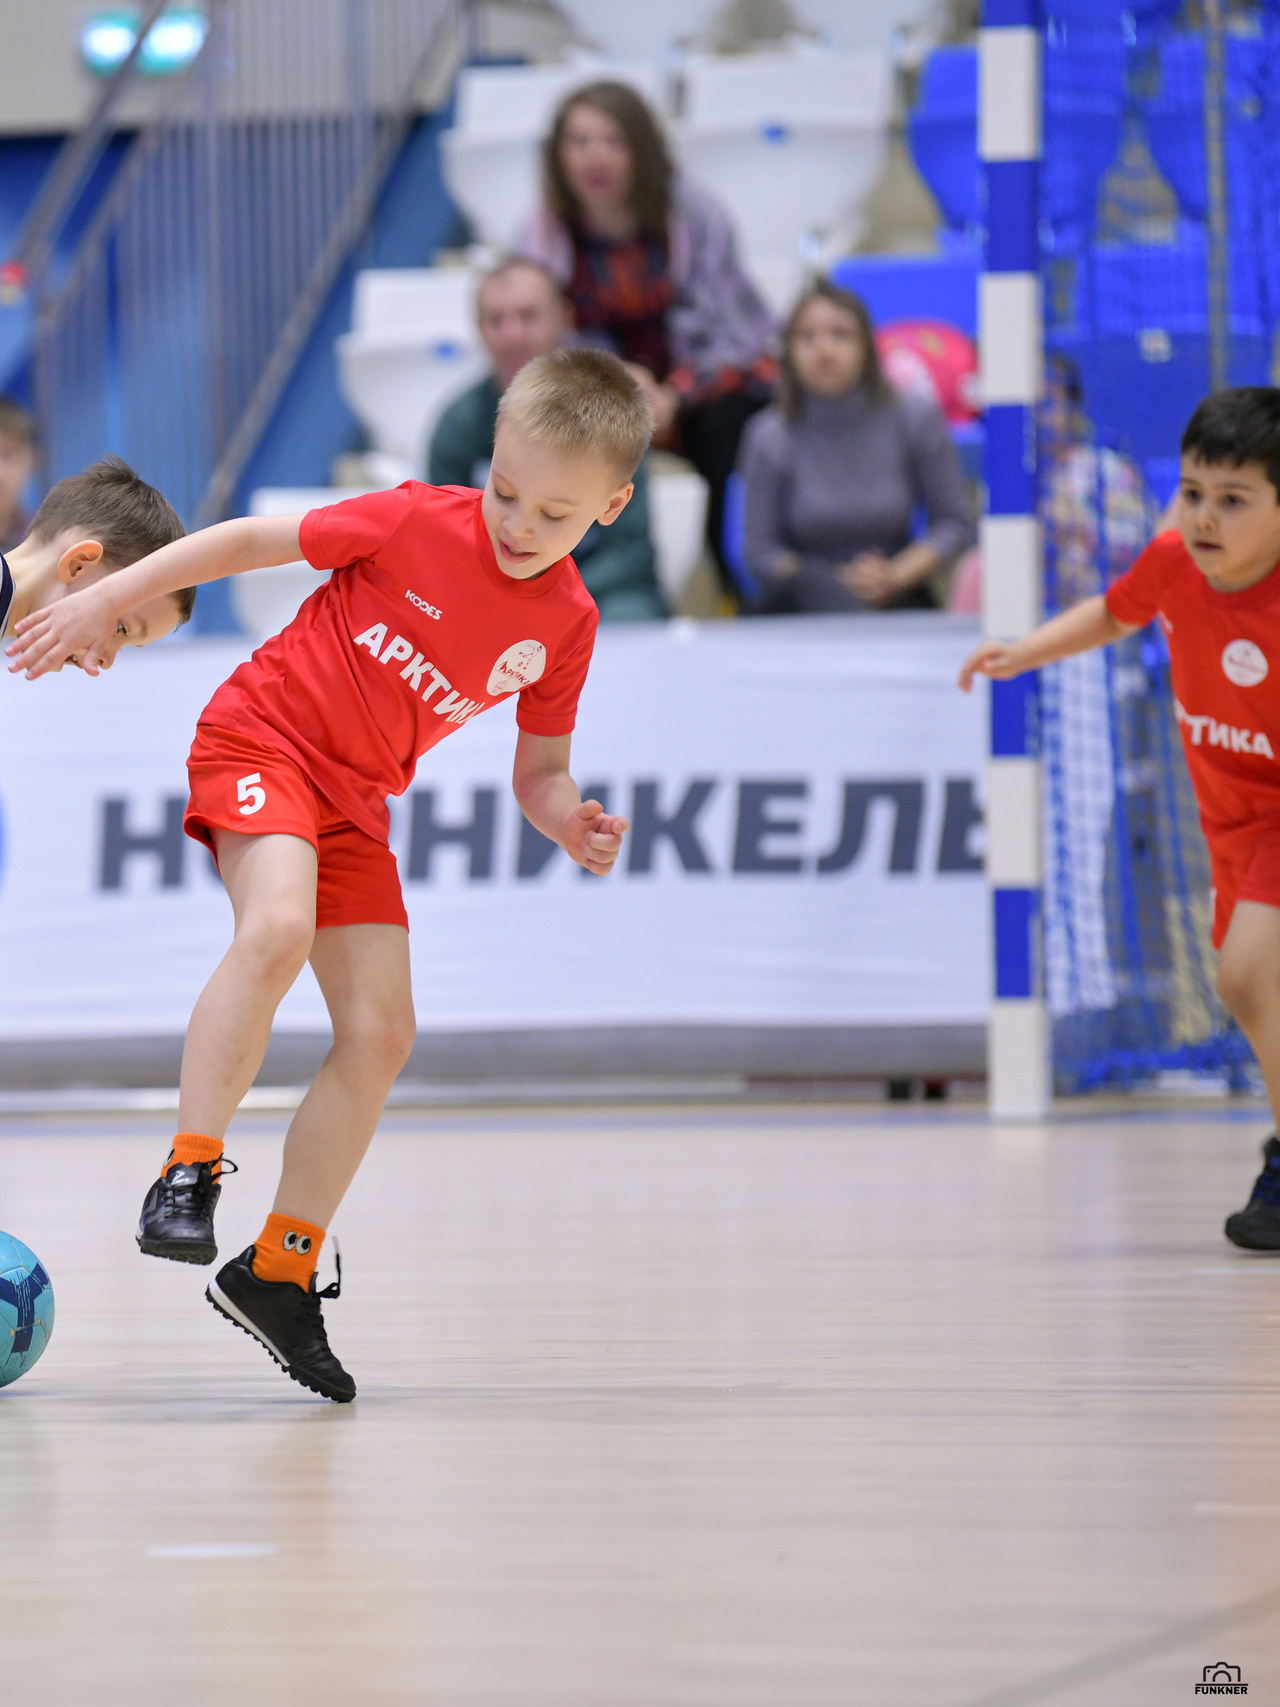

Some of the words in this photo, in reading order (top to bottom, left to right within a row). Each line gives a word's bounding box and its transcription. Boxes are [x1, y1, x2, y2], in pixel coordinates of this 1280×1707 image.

[1174, 697, 1275, 760] ТИКА
[236, 772, 266, 815] 5
[99, 775, 986, 890] ННКЕЛЬ
